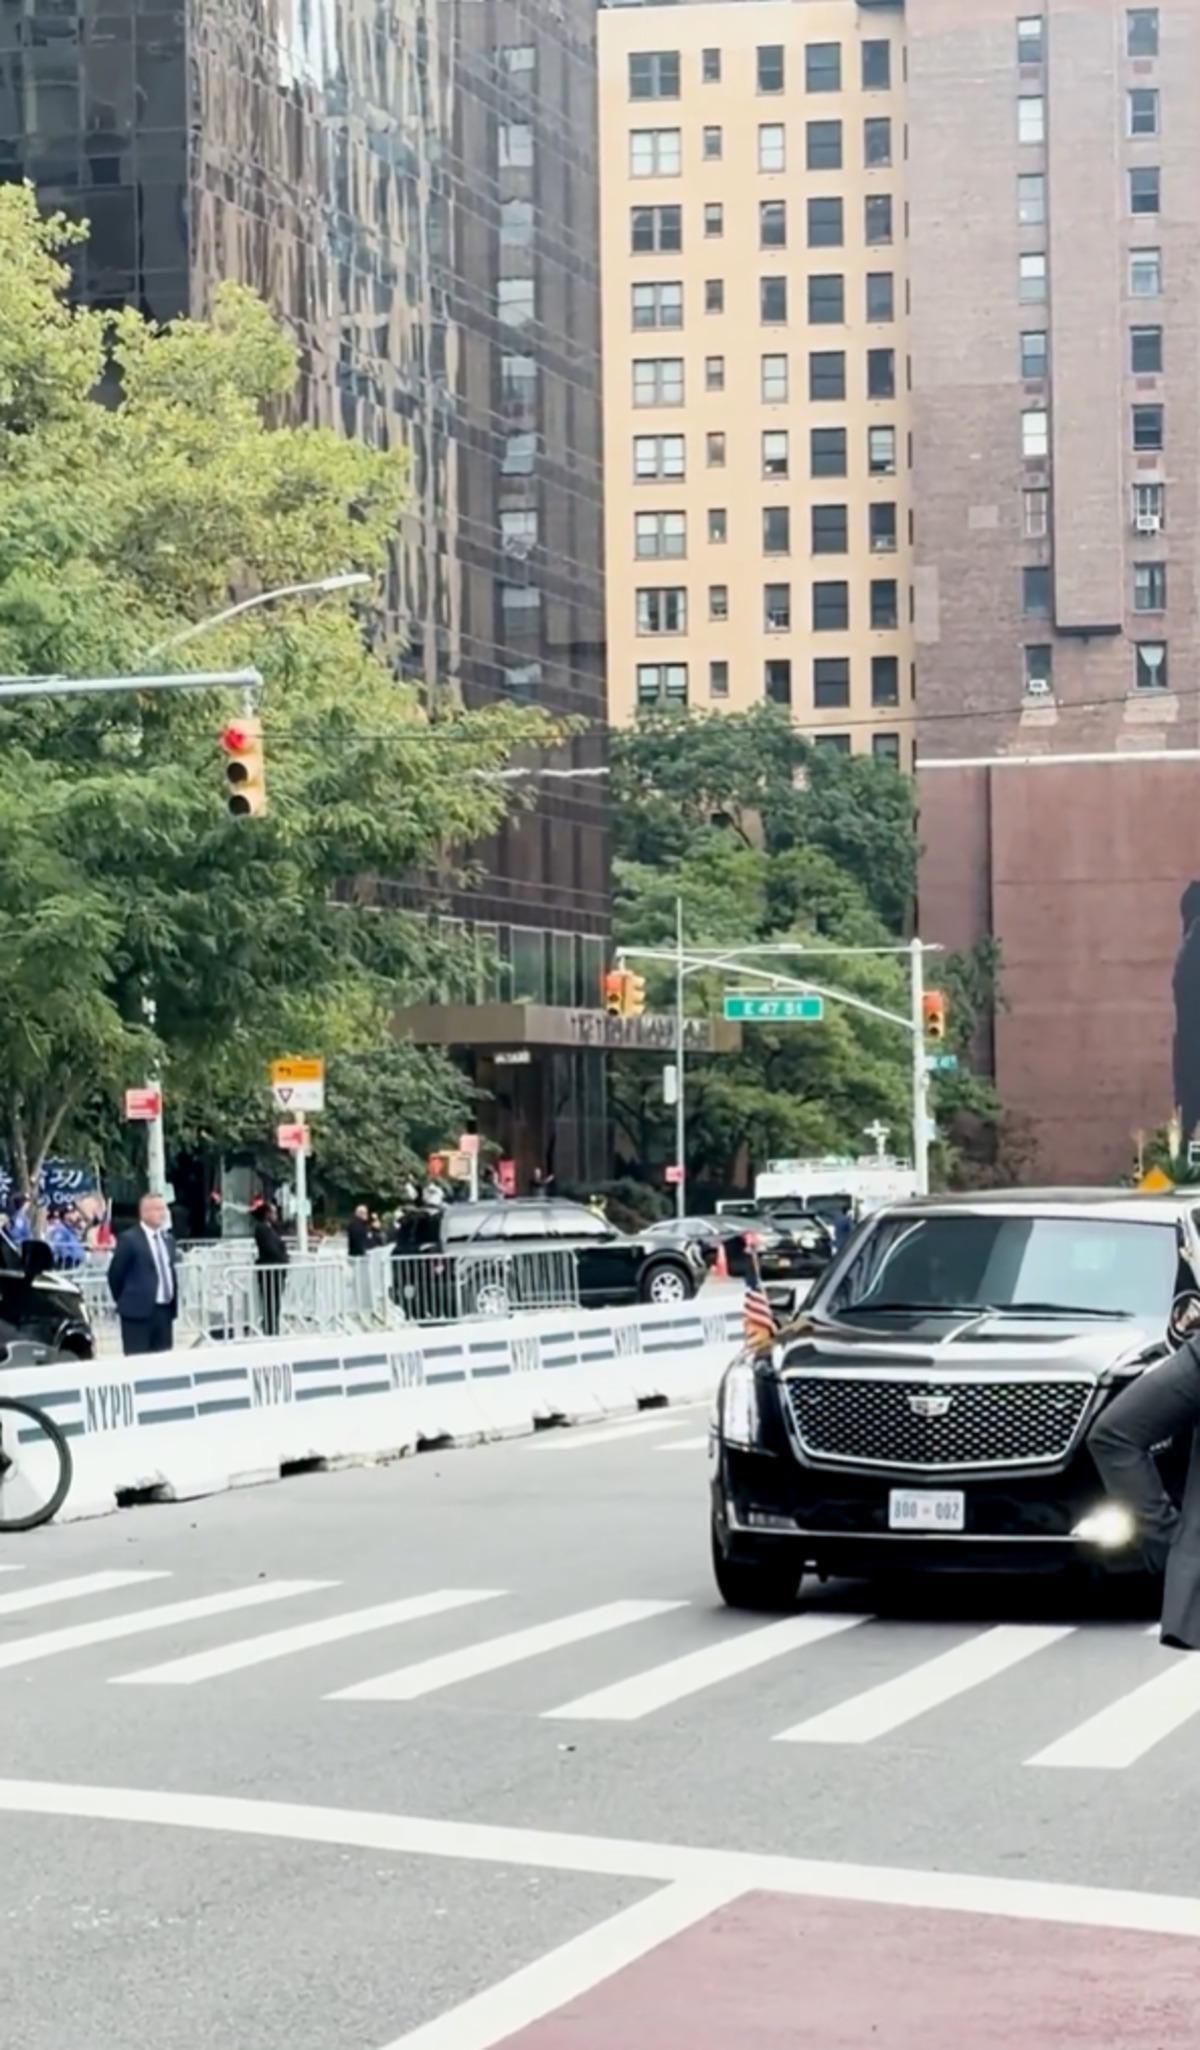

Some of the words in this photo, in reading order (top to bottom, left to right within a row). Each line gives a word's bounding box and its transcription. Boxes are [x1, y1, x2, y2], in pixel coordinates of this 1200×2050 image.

[744, 1002, 754, 1016] E
[757, 1002, 783, 1016] 47
[787, 1001, 804, 1016] St
[252, 1363, 292, 1407] NYPD
[84, 1382, 134, 1433] NYPD
